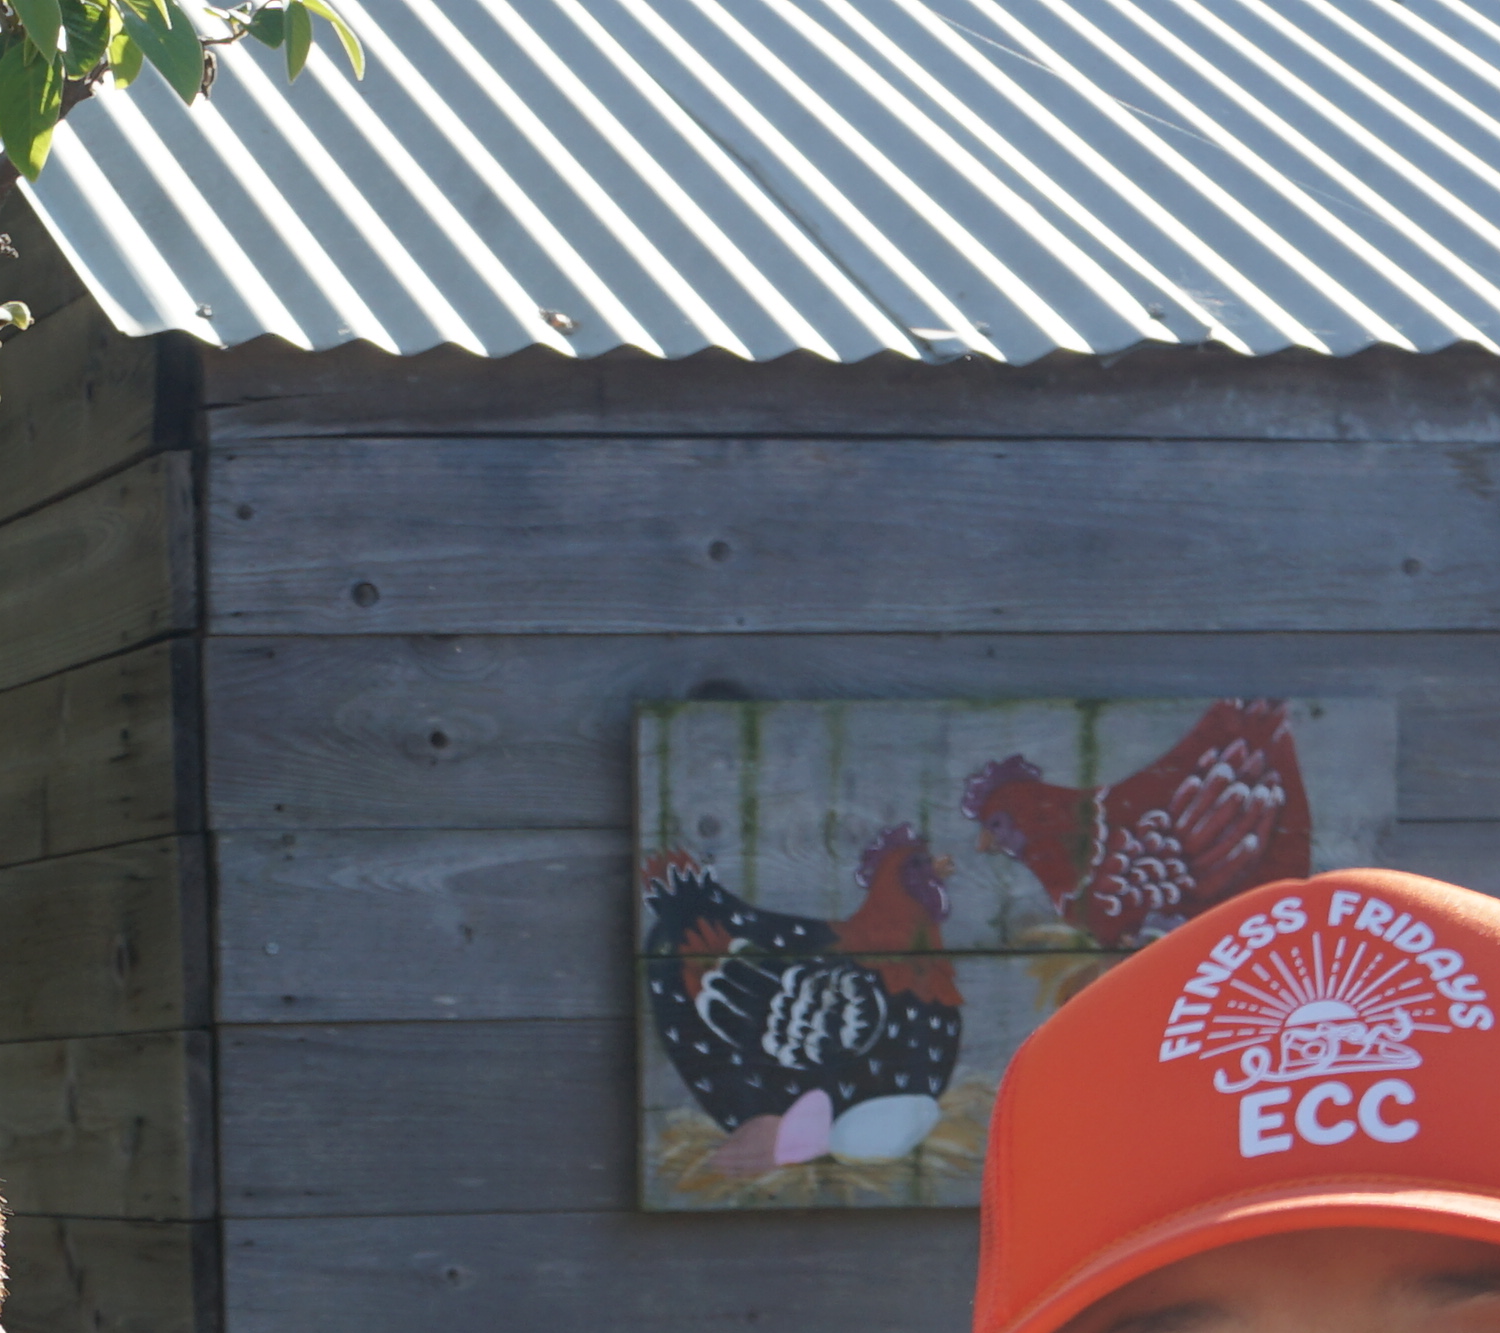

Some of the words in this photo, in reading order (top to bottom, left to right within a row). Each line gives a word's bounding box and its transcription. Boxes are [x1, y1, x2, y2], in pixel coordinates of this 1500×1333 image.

[1158, 896, 1308, 1063] FITNESS
[1327, 889, 1495, 1031] FRIDAYS
[1238, 1077, 1420, 1159] ECC
